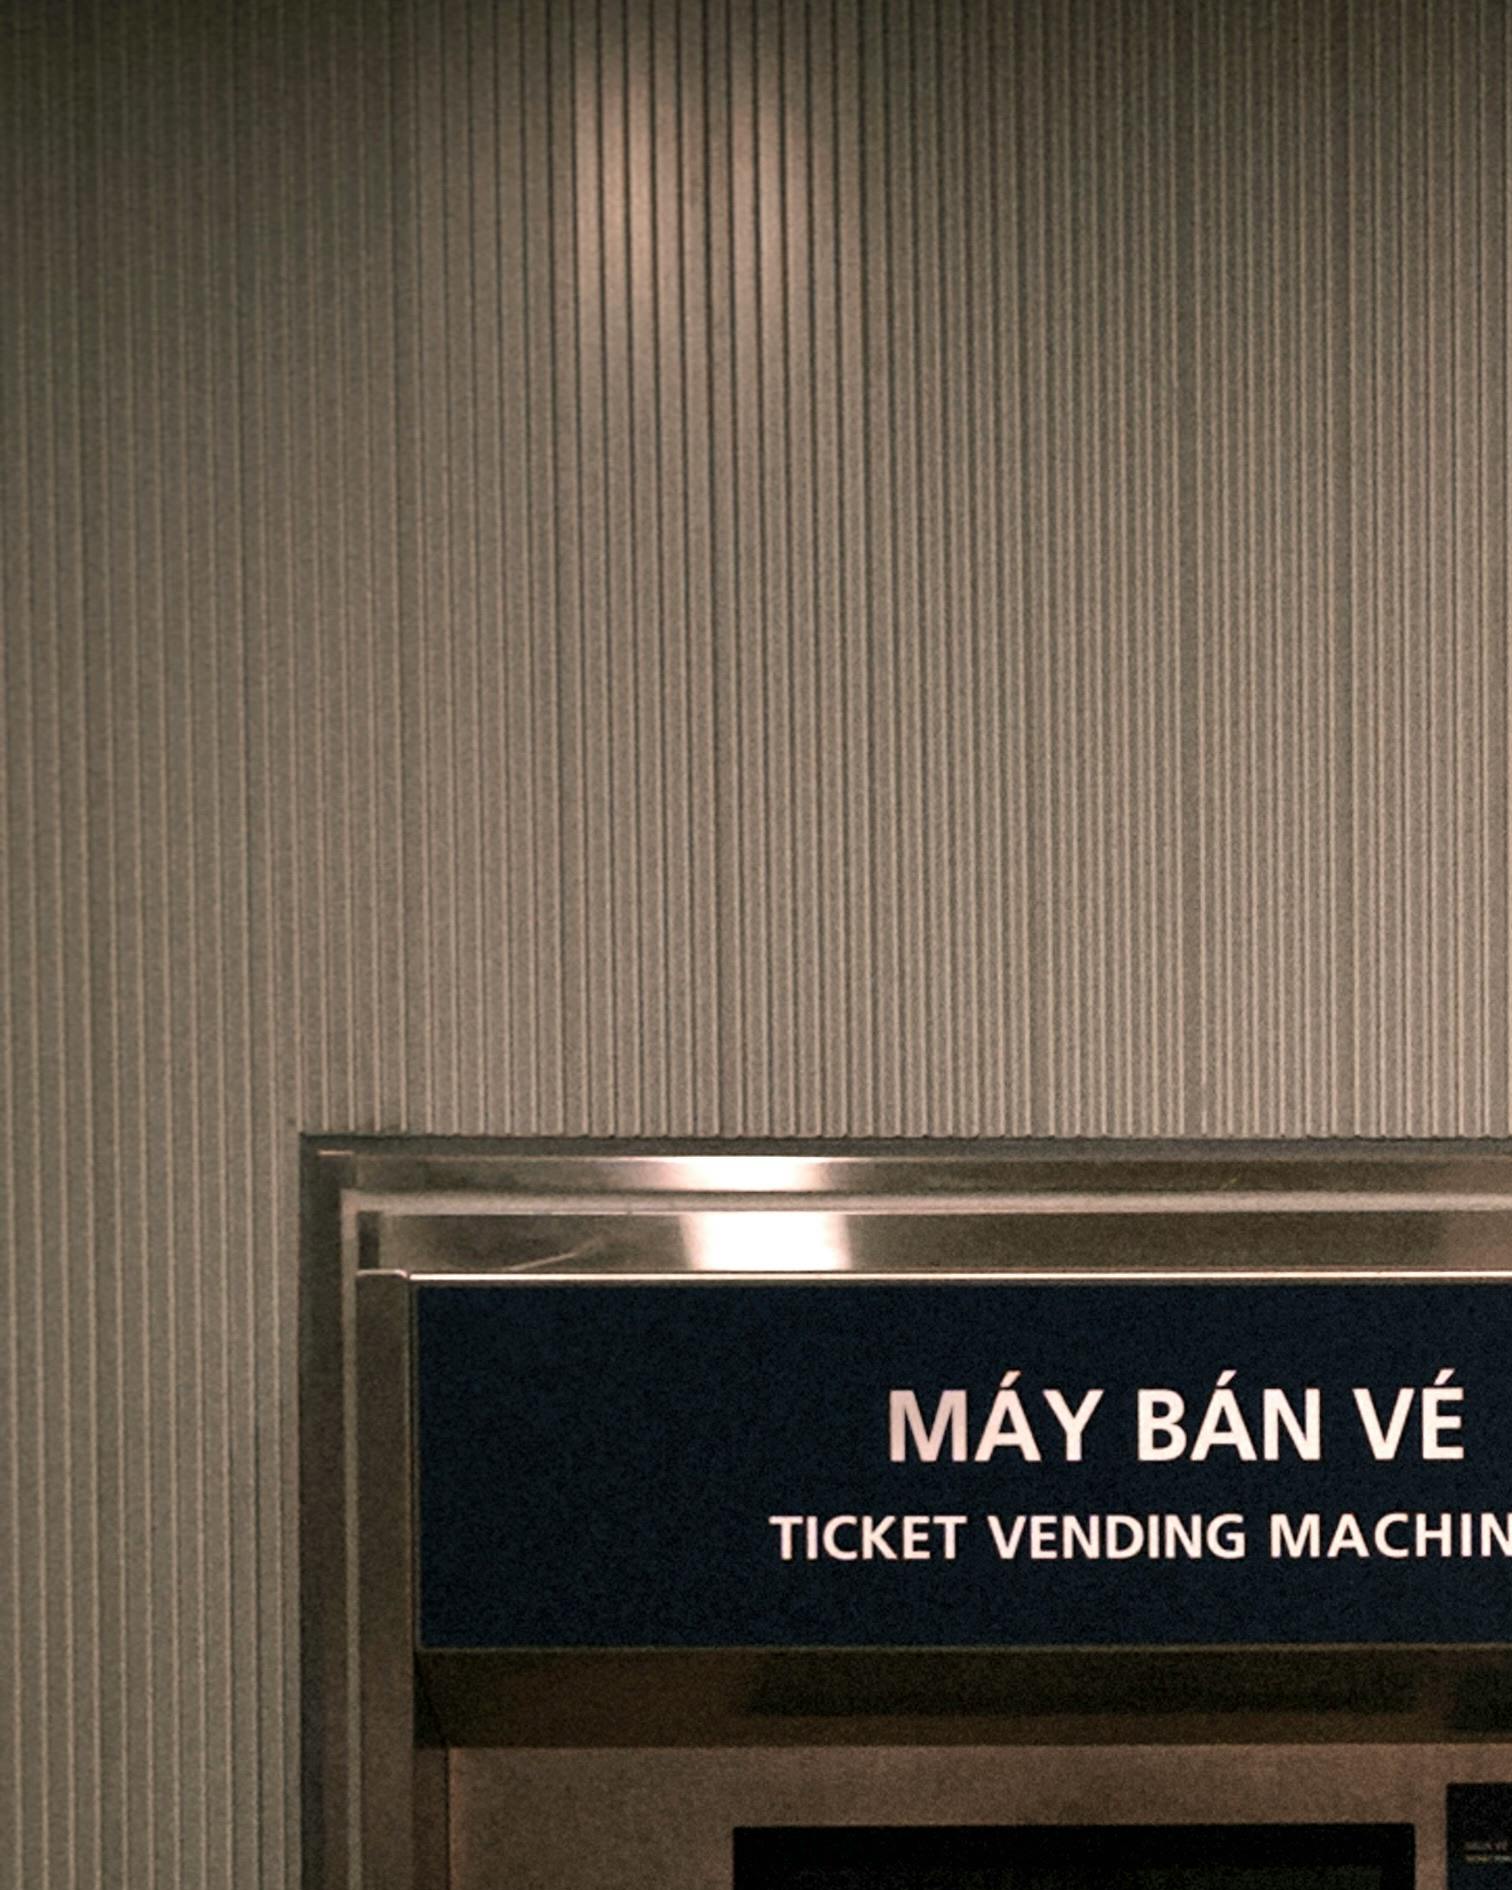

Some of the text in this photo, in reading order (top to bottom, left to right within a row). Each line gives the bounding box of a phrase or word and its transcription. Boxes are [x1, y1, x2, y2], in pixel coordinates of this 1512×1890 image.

[890, 1369, 1464, 1462] MÁY BÁN VÉ
[769, 1515, 967, 1560] TICKET
[988, 1514, 1245, 1559] VENDING
